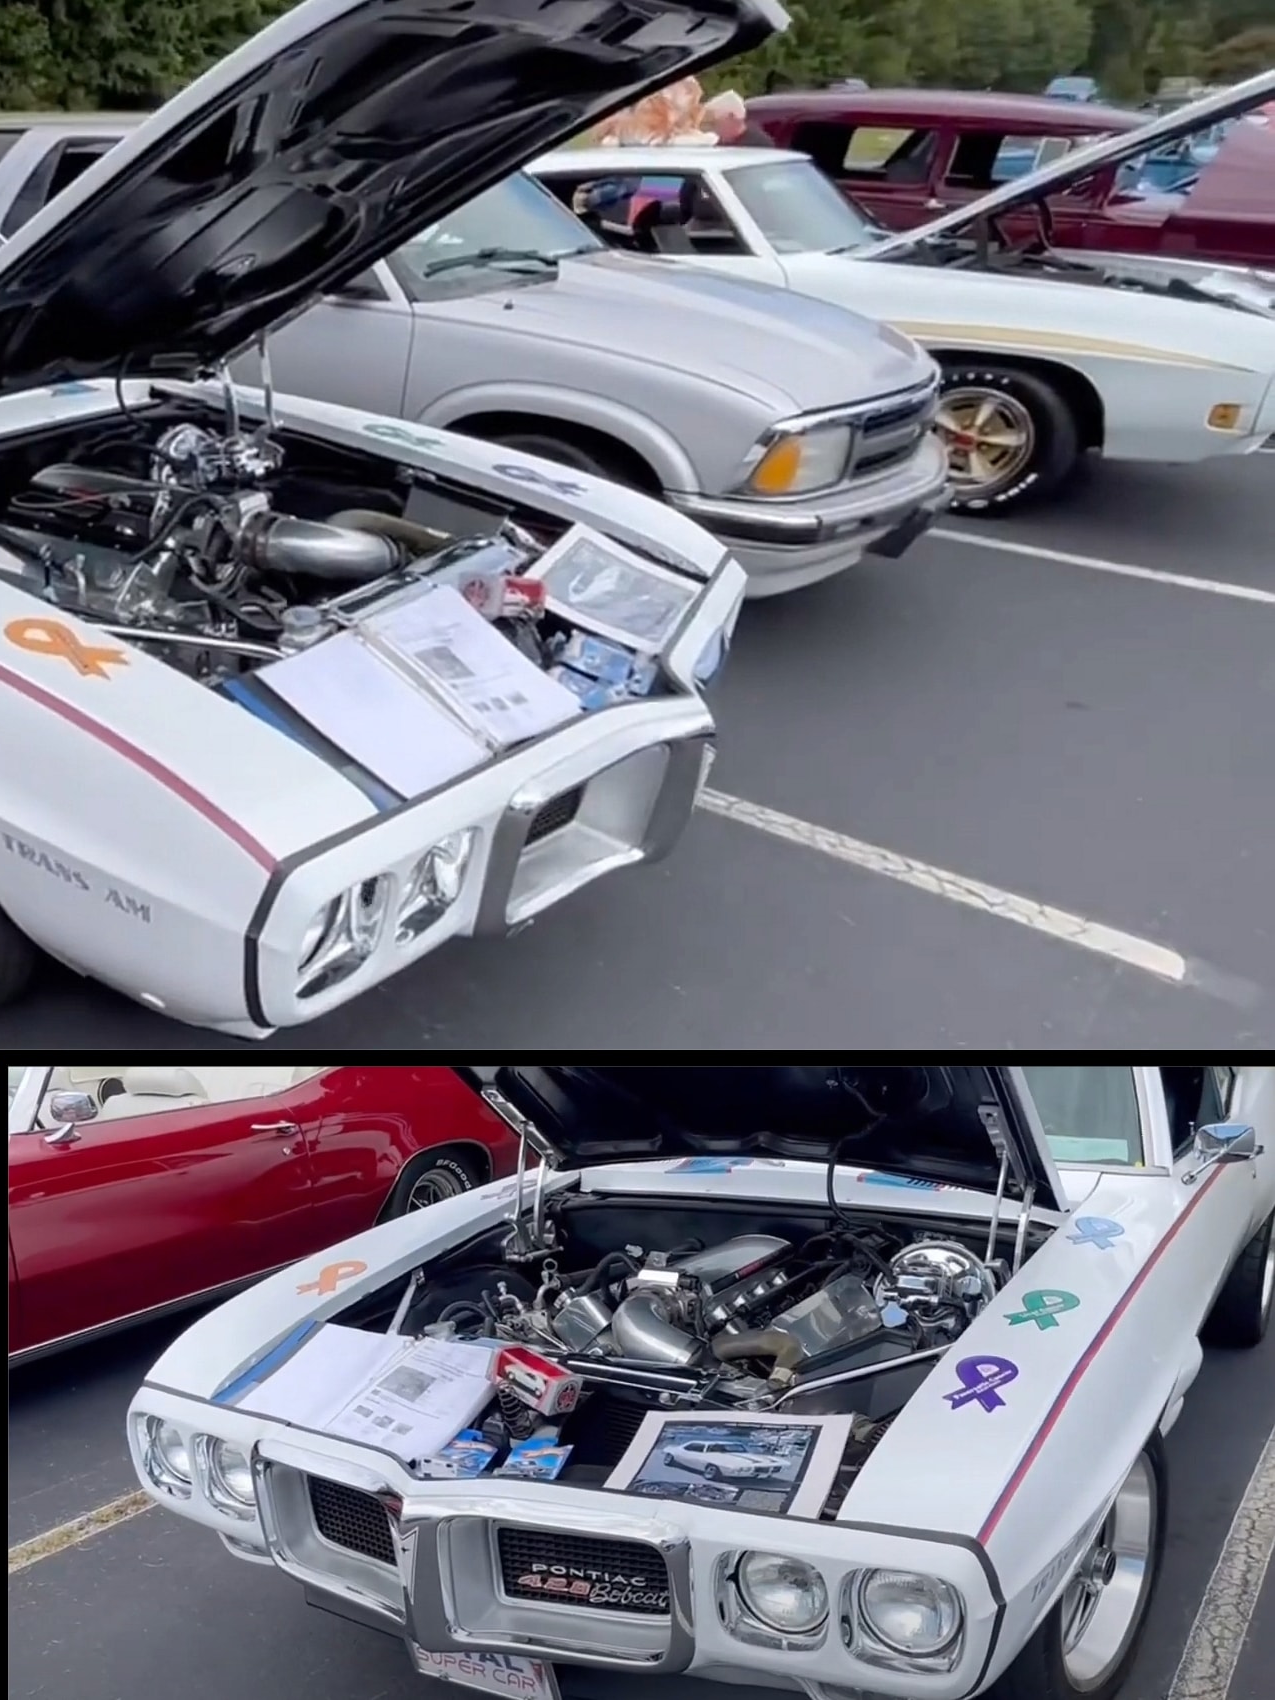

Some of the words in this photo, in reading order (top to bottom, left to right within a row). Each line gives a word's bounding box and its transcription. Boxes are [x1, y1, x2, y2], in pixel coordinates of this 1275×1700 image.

[1, 832, 89, 890] TRANS
[105, 888, 151, 923] AM
[517, 1574, 592, 1596] 428
[588, 1582, 671, 1608] Bobcat
[531, 1563, 647, 1587] PONTIAC
[415, 1646, 487, 1678] SUPER
[492, 1668, 537, 1693] CAR
